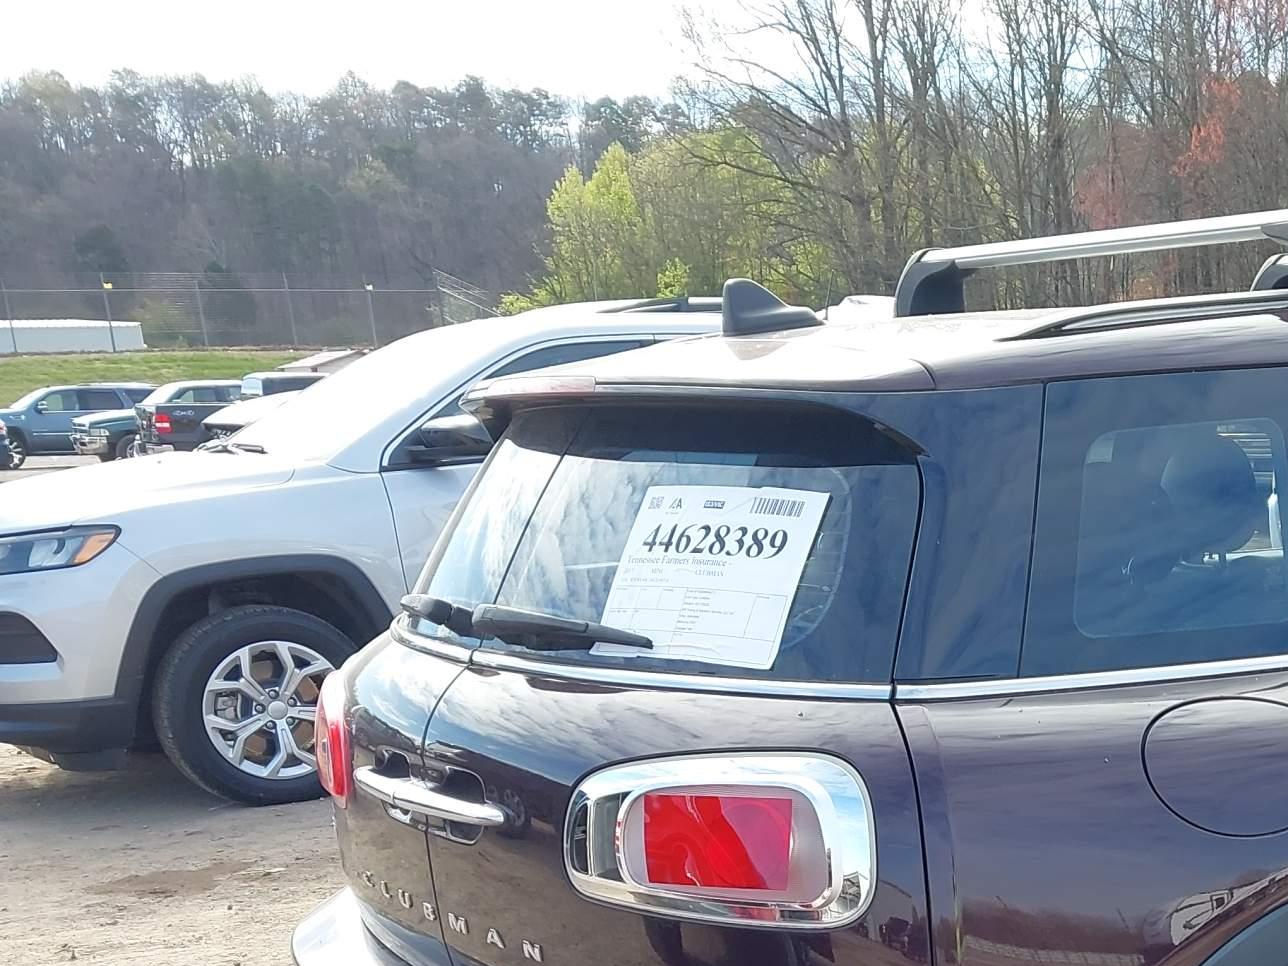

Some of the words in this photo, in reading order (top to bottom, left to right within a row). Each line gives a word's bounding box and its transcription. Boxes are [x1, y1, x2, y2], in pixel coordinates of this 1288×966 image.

[642, 523, 789, 560] 44628389
[627, 555, 661, 565] Tennessee
[661, 555, 689, 566] Farmers
[692, 556, 727, 567] Insurance
